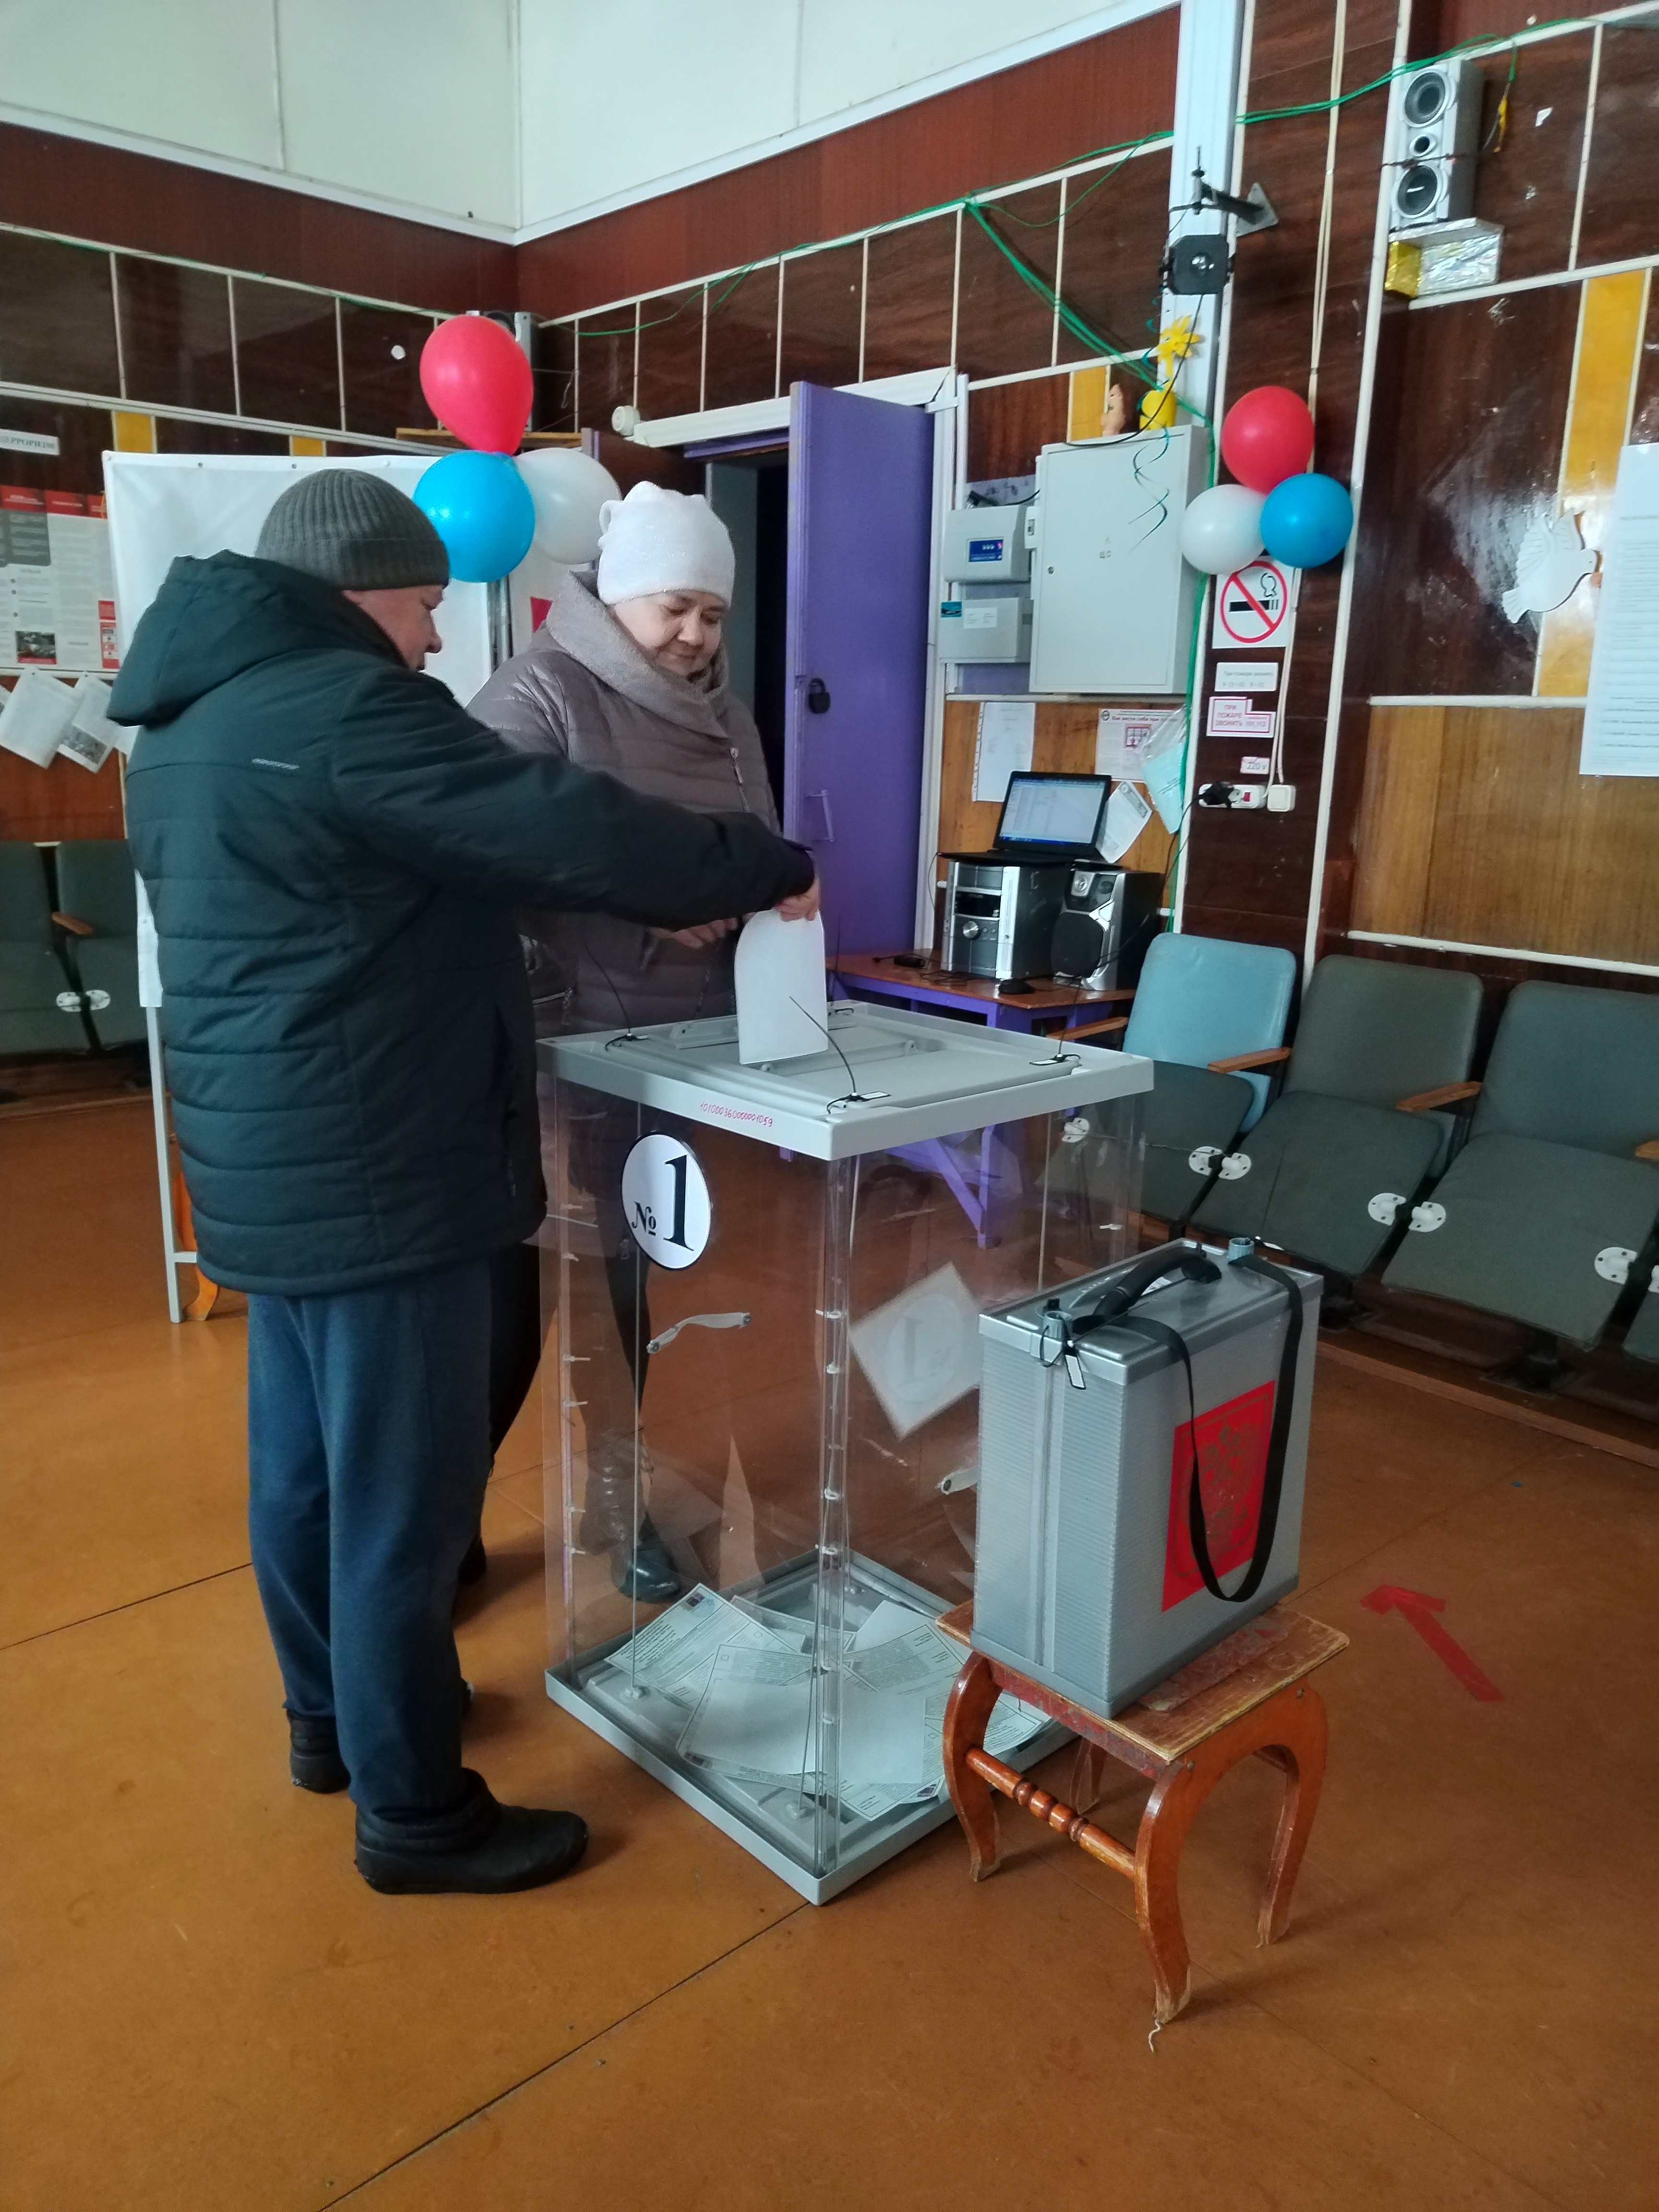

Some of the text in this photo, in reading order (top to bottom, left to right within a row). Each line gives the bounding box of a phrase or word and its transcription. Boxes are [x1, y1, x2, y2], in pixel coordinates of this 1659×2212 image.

[1247, 762, 1261, 770] 220
[631, 1154, 694, 1251] № 1
